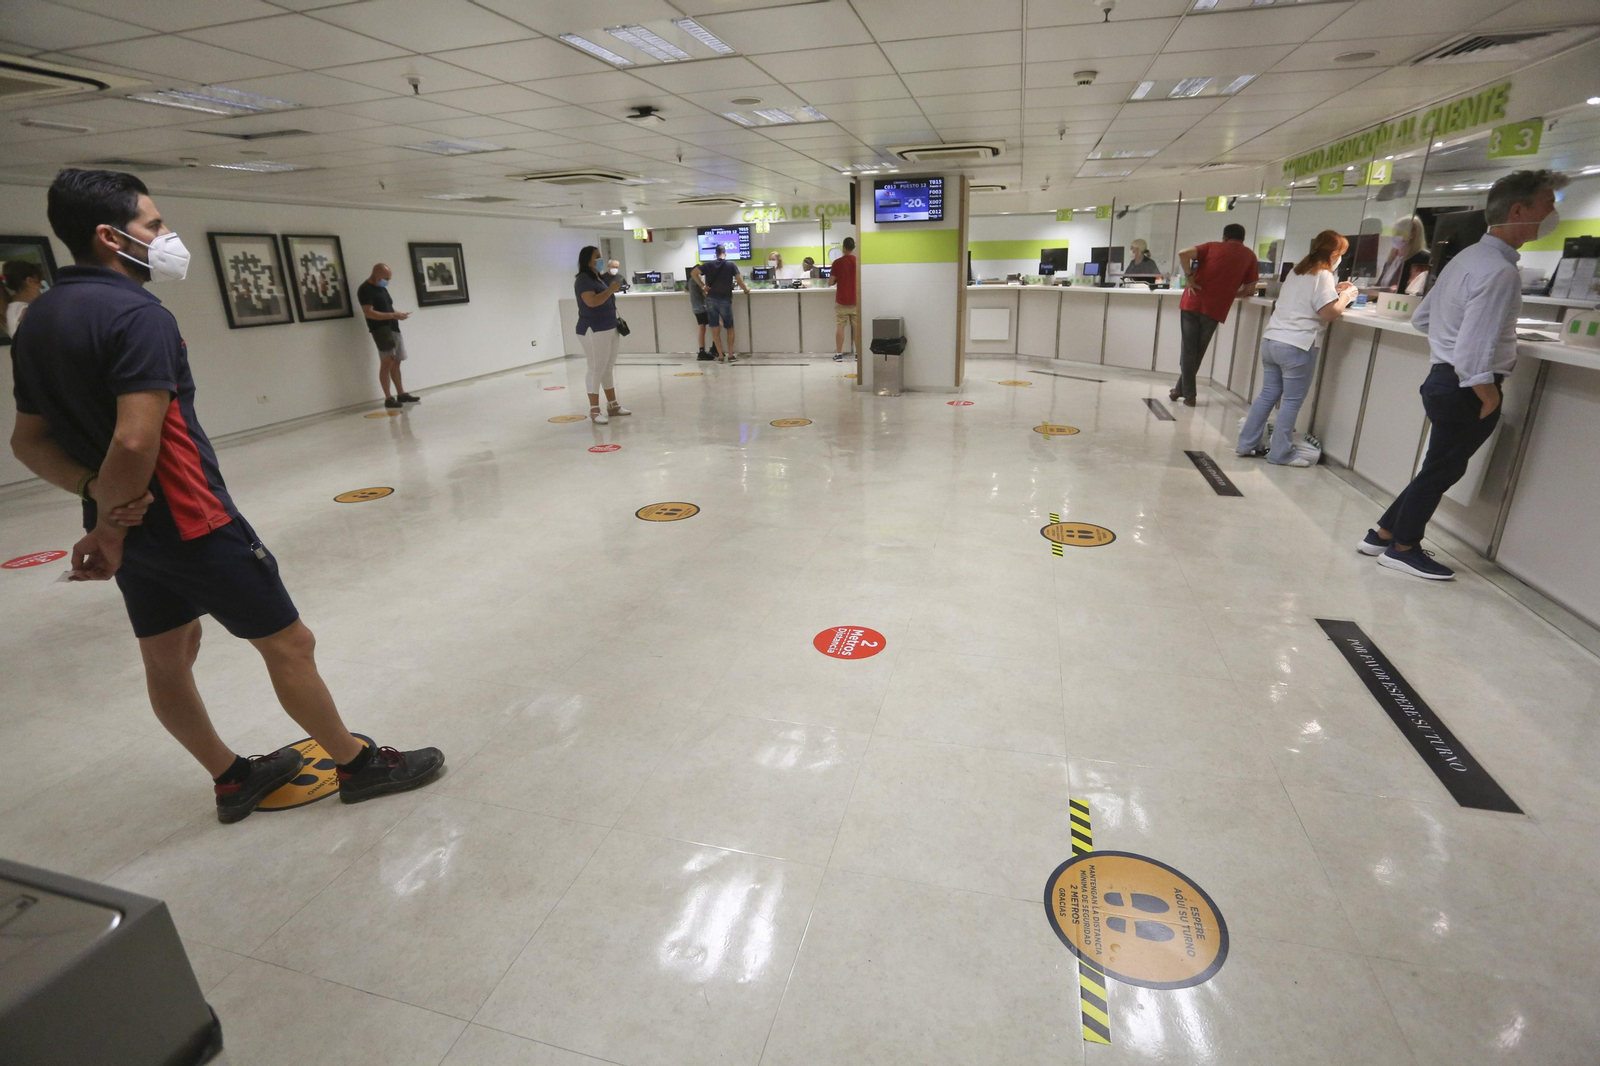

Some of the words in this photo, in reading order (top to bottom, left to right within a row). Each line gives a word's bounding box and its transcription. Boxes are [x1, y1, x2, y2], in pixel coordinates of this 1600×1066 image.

[1421, 82, 1512, 140] CLIENTE
[1514, 128, 1534, 150] 3
[1328, 178, 1338, 191] 5
[1372, 165, 1387, 182] 4
[742, 207, 788, 222] CARTA
[791, 204, 810, 219] DE
[827, 627, 848, 654] Distancia
[841, 629, 865, 656] Metros
[861, 639, 878, 648] 2
[1347, 637, 1368, 654] POR
[1360, 654, 1391, 680] FAVOR
[1382, 680, 1420, 717] ESPERE
[1411, 716, 1434, 733] SU
[1425, 731, 1468, 772] TURNO
[1080, 869, 1088, 893] MÍNIMA
[1089, 864, 1098, 905] MANTENGAN
[1059, 887, 1067, 917] GRACIAS
[1070, 891, 1080, 925] METROS
[1081, 894, 1088, 904] DE
[1092, 906, 1100, 915] LA
[1174, 887, 1187, 909] AQUÍ
[1082, 904, 1091, 946] SEGURIDAD
[1179, 910, 1188, 926] SU
[1190, 906, 1206, 940] ESPERE
[1092, 916, 1103, 956] DISTANCIA
[1182, 926, 1196, 958] TURNO
